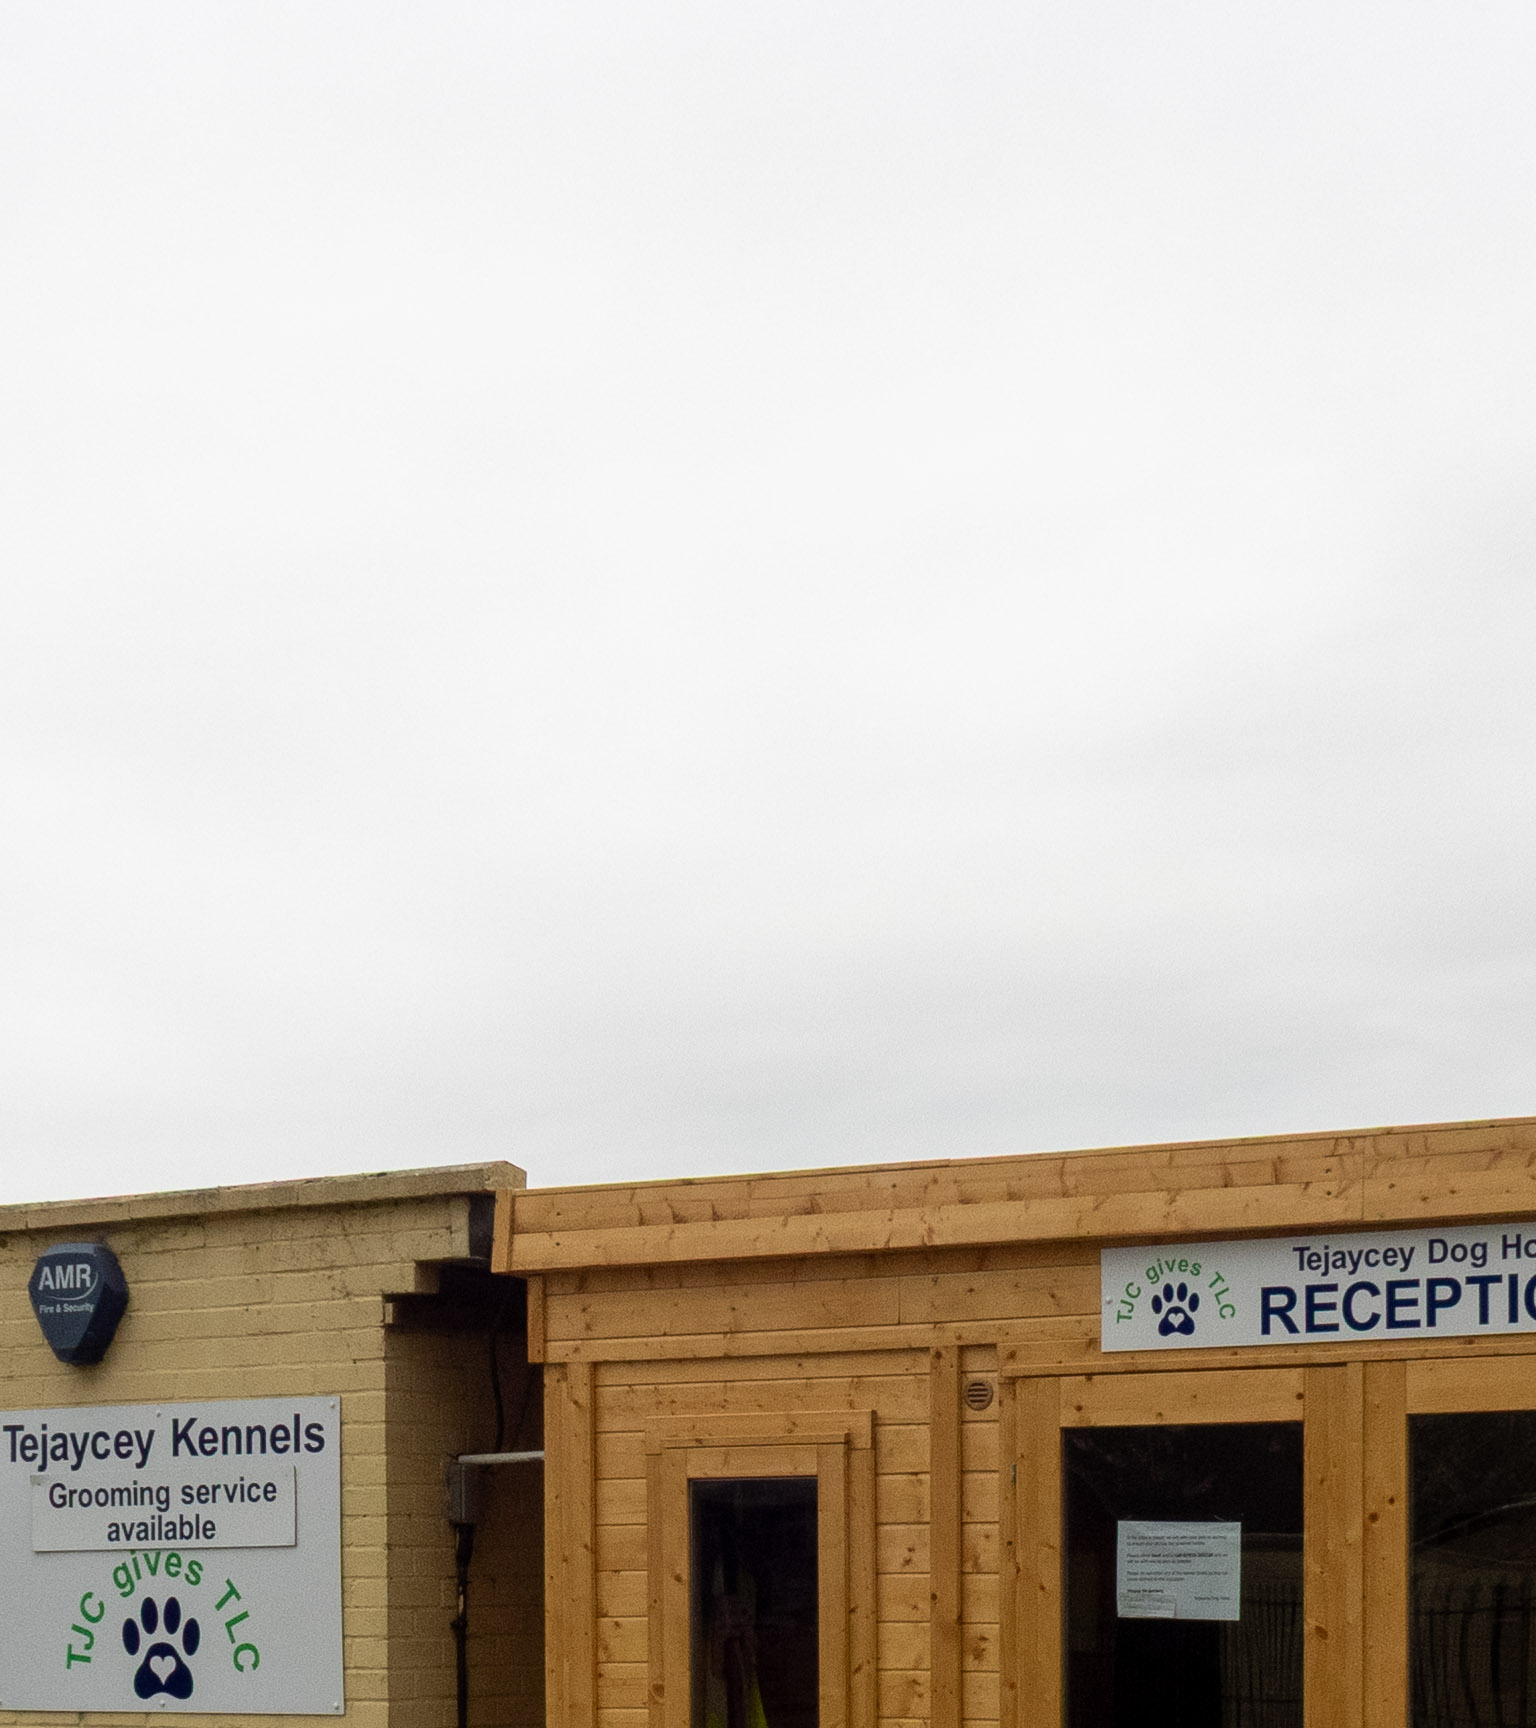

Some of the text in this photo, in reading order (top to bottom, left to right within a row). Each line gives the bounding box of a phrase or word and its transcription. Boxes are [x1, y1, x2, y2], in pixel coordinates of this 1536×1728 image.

[1293, 1244, 1416, 1277] Tejaycey
[1428, 1237, 1488, 1269] Dog
[38, 1264, 91, 1291] AMR
[1116, 1258, 1236, 1324] TJC gives TLC
[63, 1302, 95, 1313] Security
[3, 1413, 325, 1473] Tejaycey Kennels
[49, 1476, 277, 1513] Grooming service
[107, 1513, 216, 1542] available
[66, 1550, 261, 1673] TJC gives TLC
